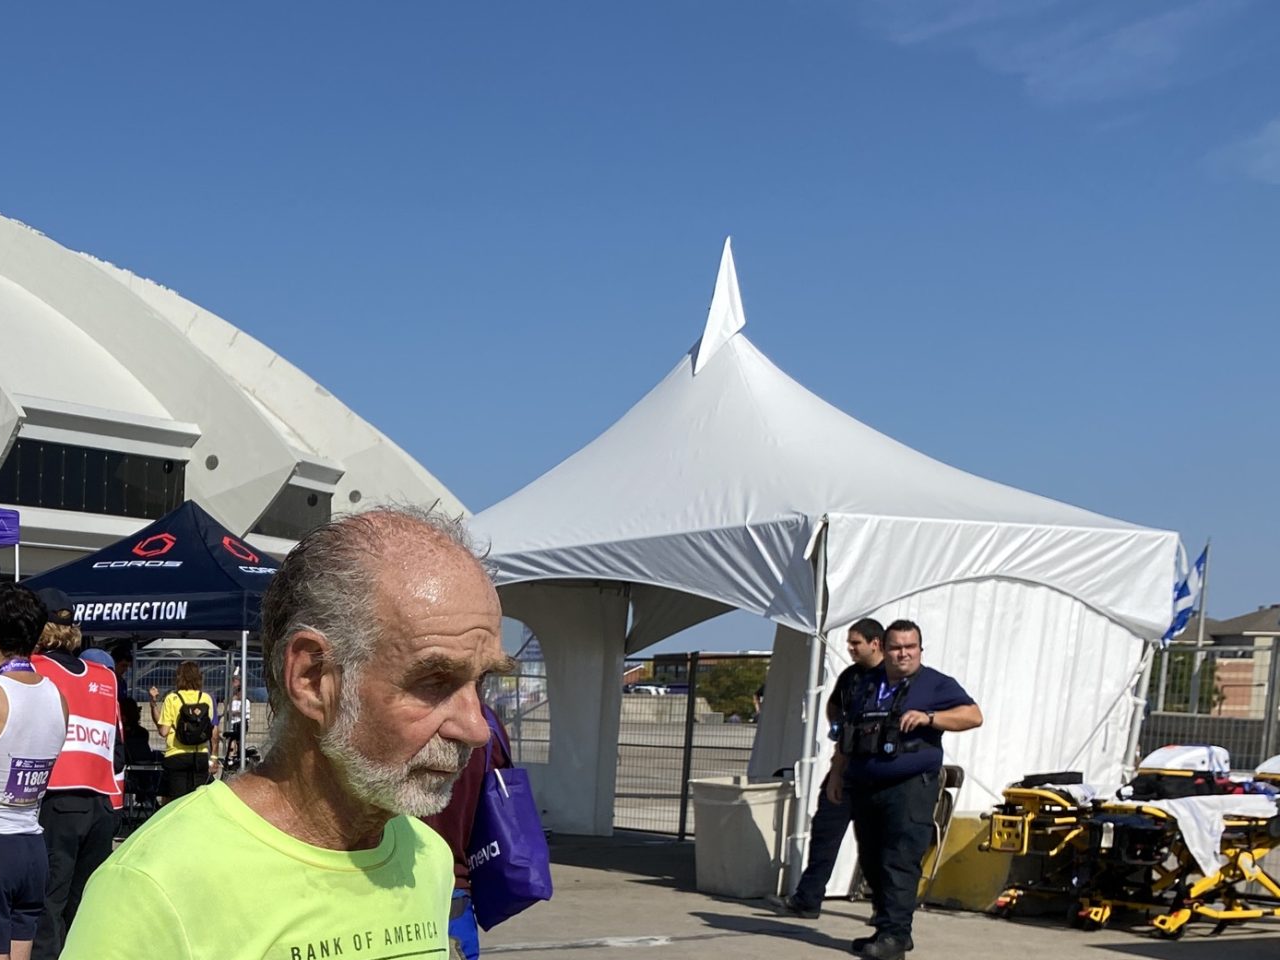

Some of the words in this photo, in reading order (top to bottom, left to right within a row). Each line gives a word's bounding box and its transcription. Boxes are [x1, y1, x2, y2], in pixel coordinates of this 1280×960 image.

[92, 560, 184, 569] COROS
[73, 601, 188, 622] REPERFECTION
[17, 770, 49, 786] 11802
[353, 931, 373, 951] OF
[384, 921, 438, 945] AMERICA
